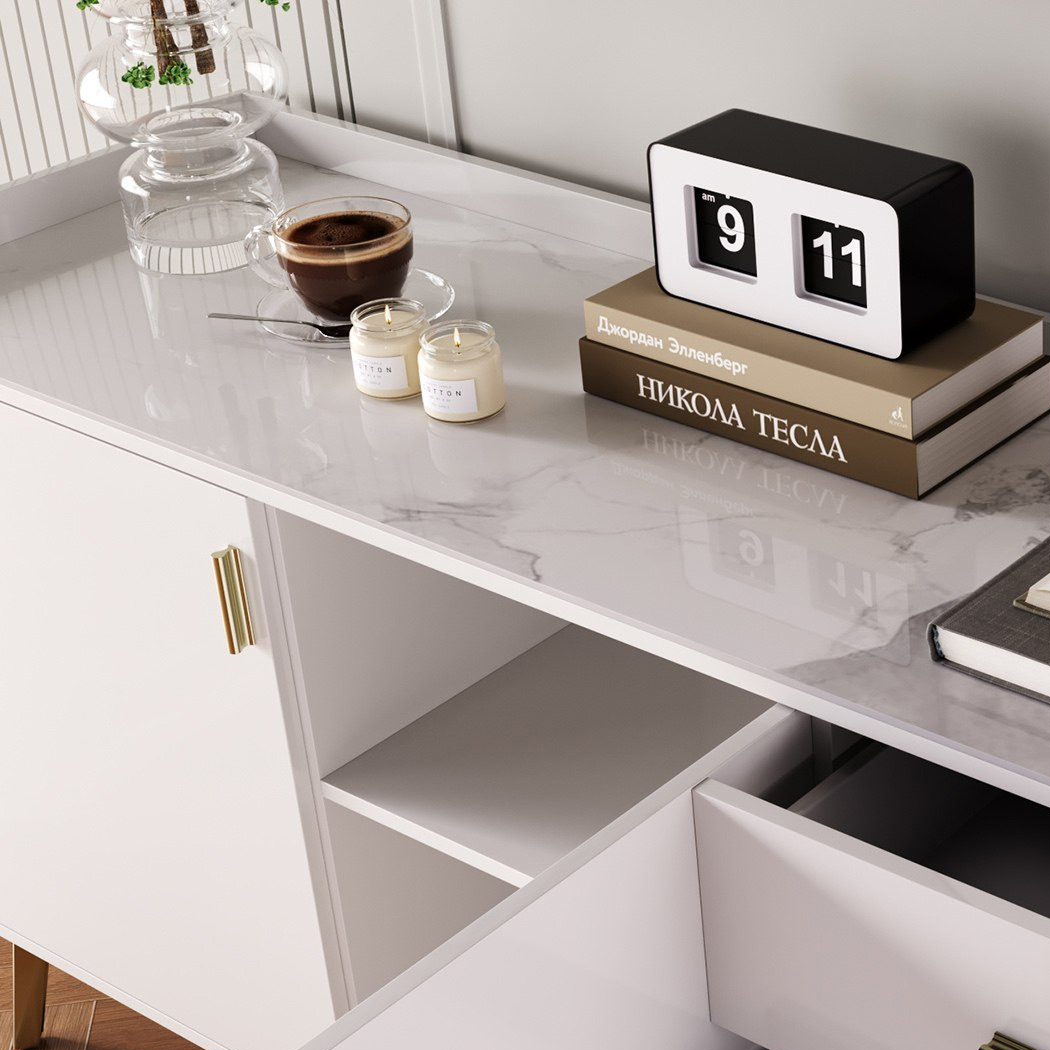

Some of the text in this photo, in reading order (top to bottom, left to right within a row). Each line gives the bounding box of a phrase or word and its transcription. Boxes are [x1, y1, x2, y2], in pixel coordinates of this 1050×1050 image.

[702, 192, 715, 203] am
[717, 204, 861, 287] 9 11
[597, 315, 748, 375] Джордан Элленберг
[636, 373, 848, 463] НИКОЛА ТЕСЛА
